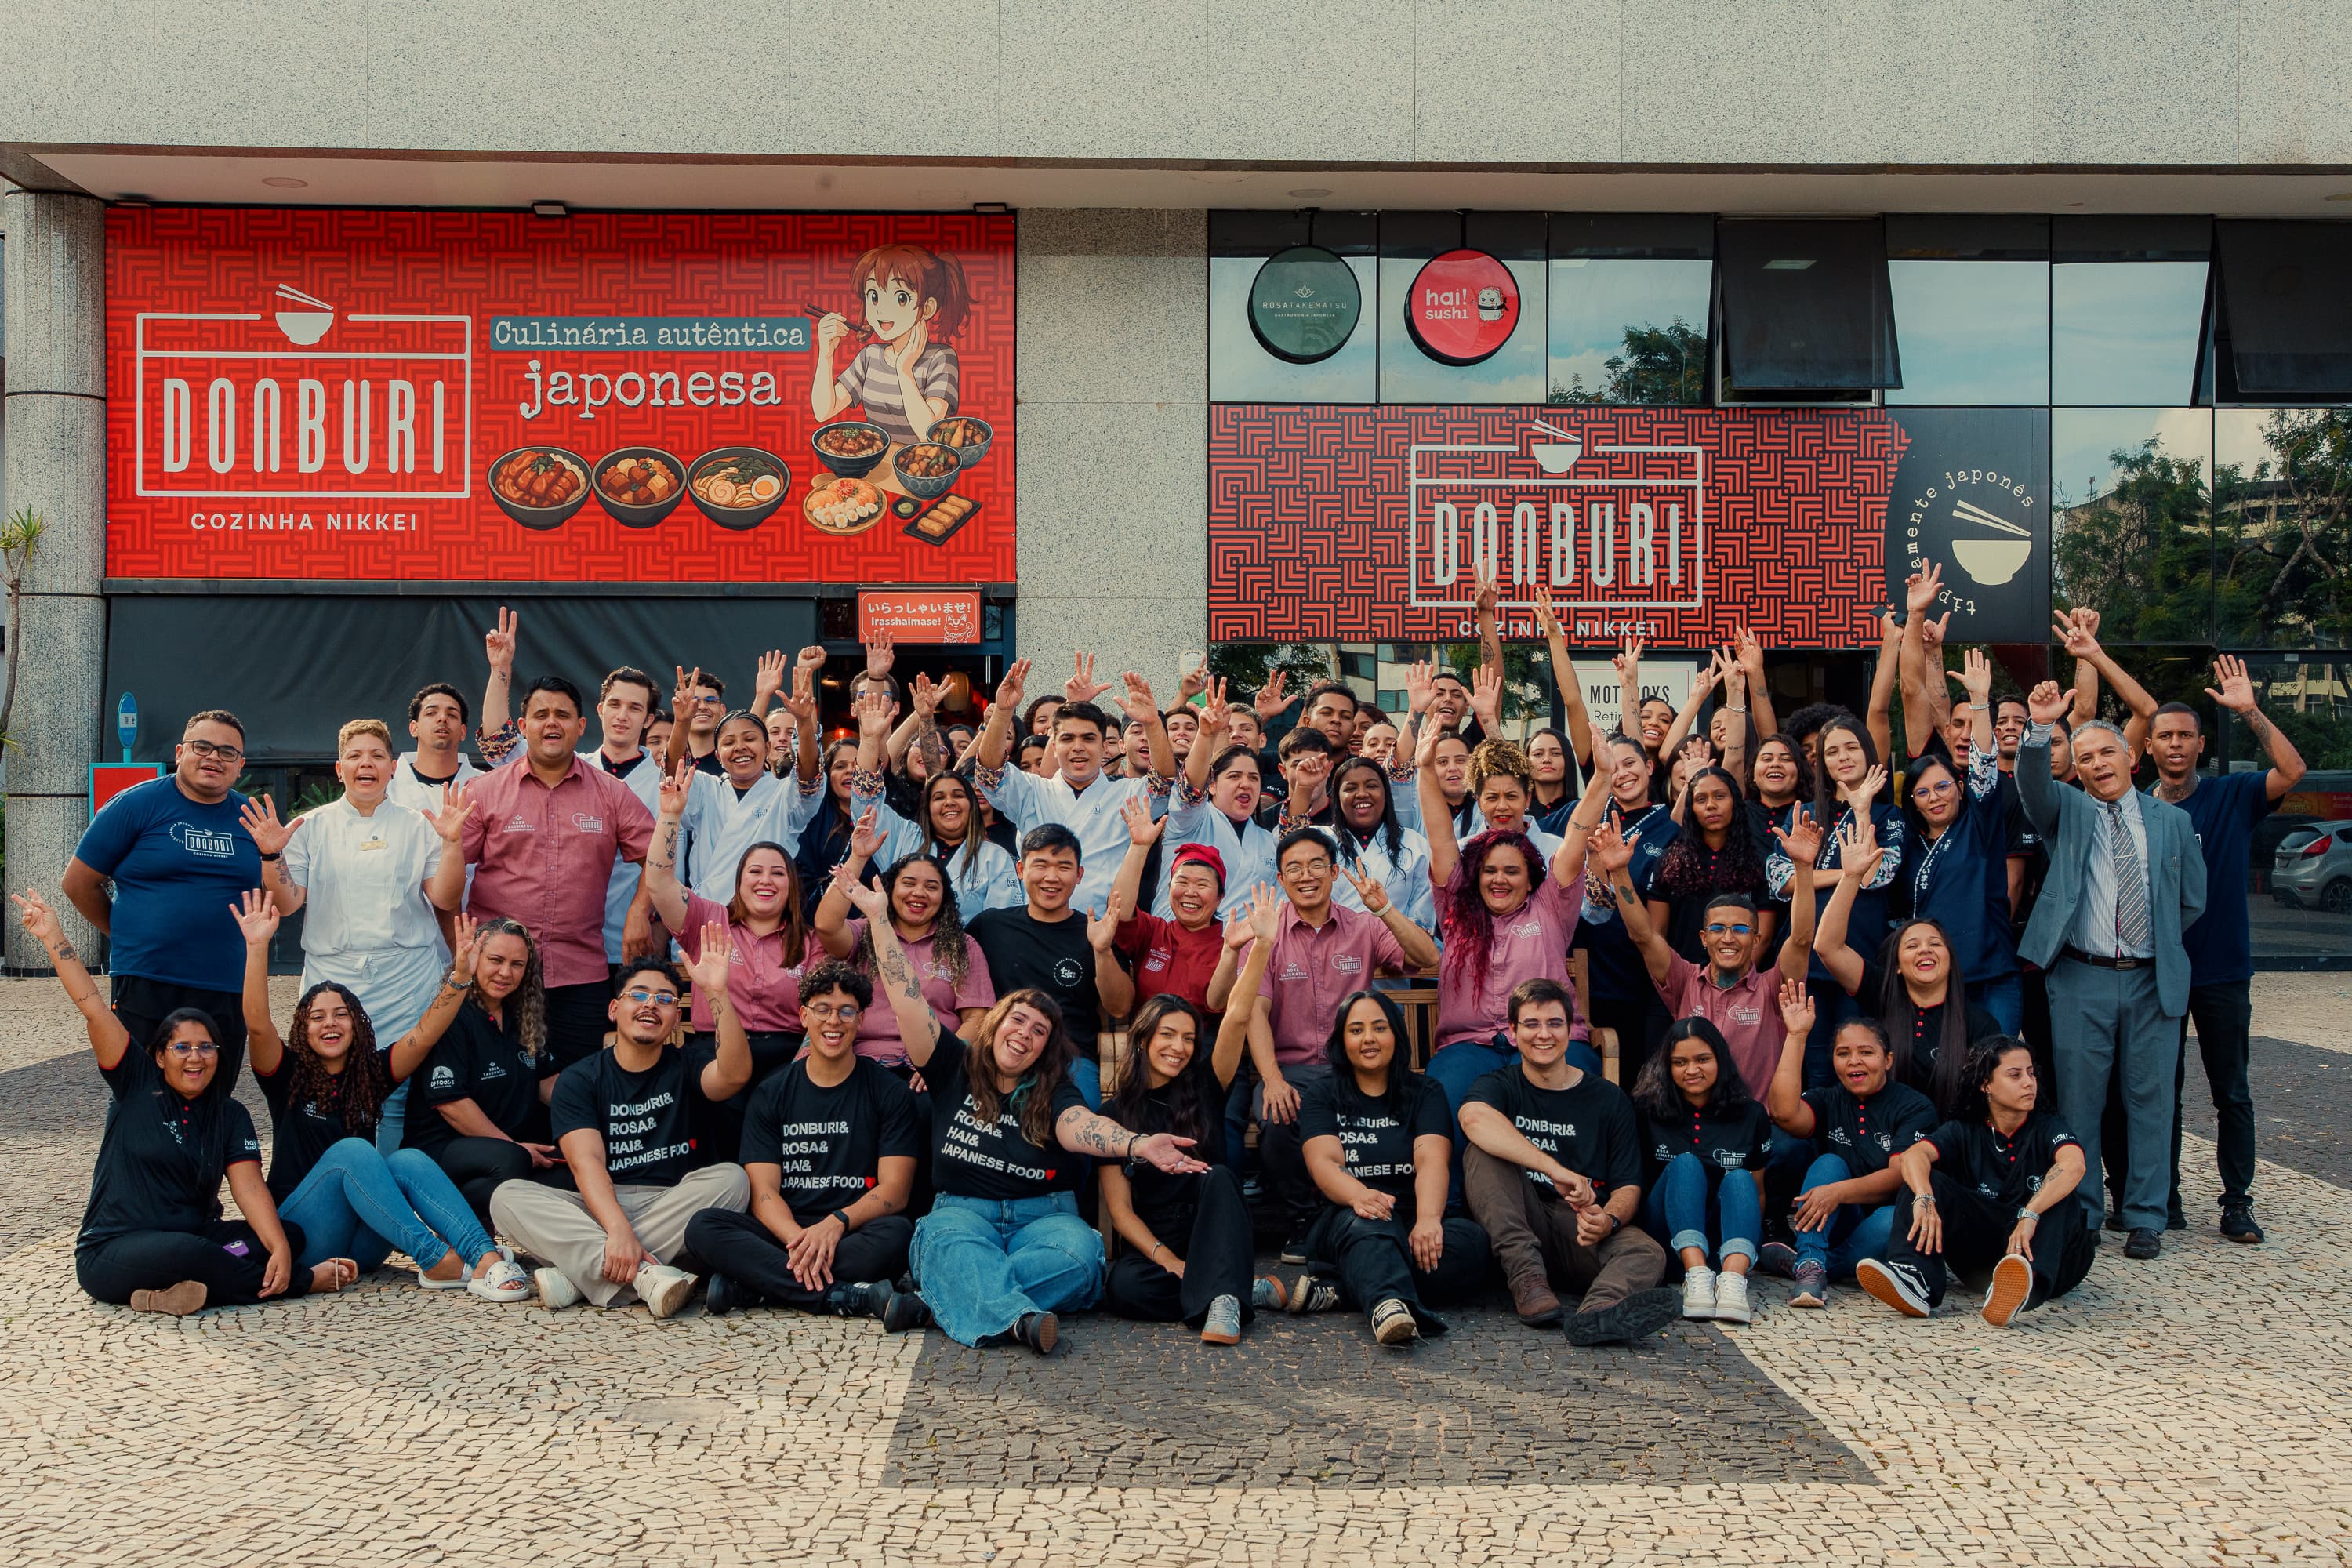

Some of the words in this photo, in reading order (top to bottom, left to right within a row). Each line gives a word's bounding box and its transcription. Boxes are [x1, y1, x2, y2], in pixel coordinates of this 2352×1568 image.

[1426, 288, 1467, 306] hai!
[1425, 306, 1469, 320] sushi
[495, 320, 648, 347] Culinária
[657, 321, 806, 348] autêntica
[519, 359, 782, 420] japonesa
[163, 377, 444, 474] DONBURI
[1945, 469, 2034, 508] japonês
[191, 513, 314, 531] COZINHA
[326, 514, 416, 532] NIKKEI
[1434, 501, 1679, 586] DONBURI
[871, 616, 941, 626] irasshaimase!
[1577, 620, 1655, 636] NIKKEI
[1590, 685, 1670, 704] MOTOYS
[190, 837, 230, 852] DONBURI
[609, 1092, 674, 1116] DONBURI&
[609, 1116, 657, 1136] ROSA&
[782, 1120, 849, 1137] DONBURI&
[953, 1109, 1003, 1139] ROSA&
[946, 1125, 980, 1147] HAI&
[1338, 1131, 1378, 1144] OSA&
[608, 1147, 668, 1171] JAPANESE
[670, 1142, 690, 1158] FOO
[609, 1139, 644, 1155] HAI&
[782, 1140, 829, 1156] ROSA&
[782, 1160, 812, 1174] HAI&
[941, 1142, 1005, 1171] JAPANESE
[1007, 1163, 1046, 1180] FOOD
[781, 1176, 832, 1189] JAPANESE
[832, 1175, 865, 1189] FOOD
